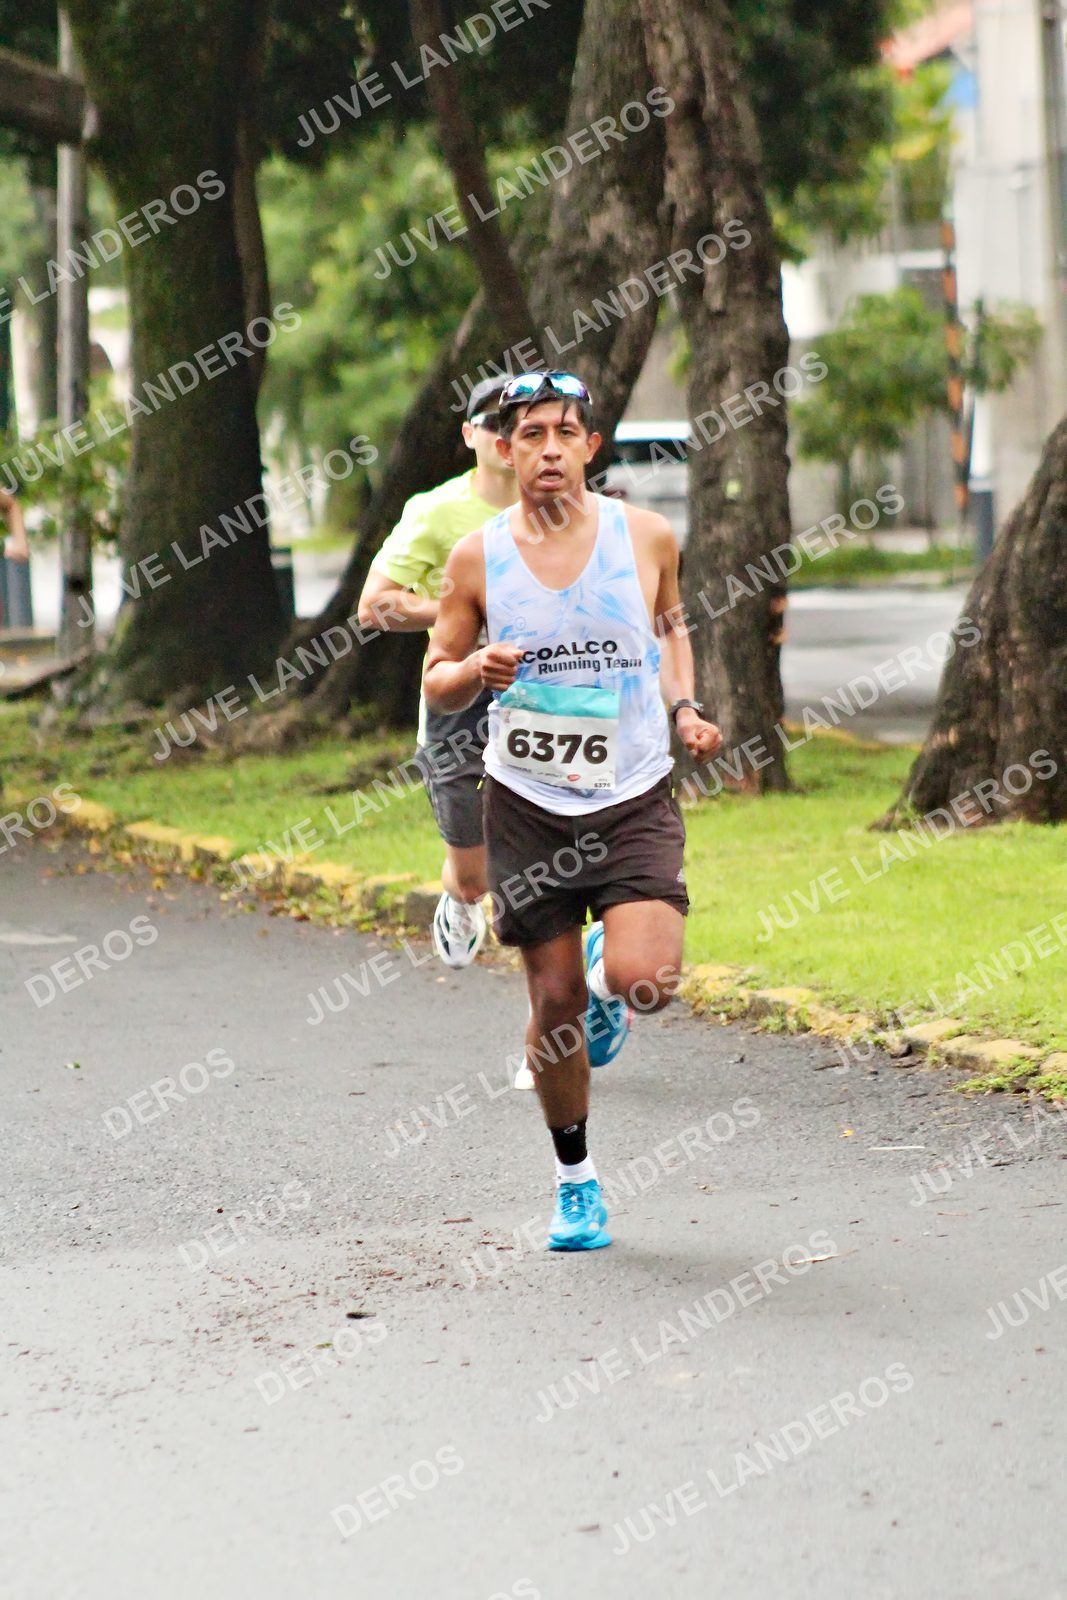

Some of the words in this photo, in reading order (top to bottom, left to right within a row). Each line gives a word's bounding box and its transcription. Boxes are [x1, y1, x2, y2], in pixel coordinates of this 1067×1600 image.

[518, 639, 618, 664] COALCO
[538, 656, 601, 675] Running
[604, 656, 642, 670] Team
[506, 727, 608, 765] 6376
